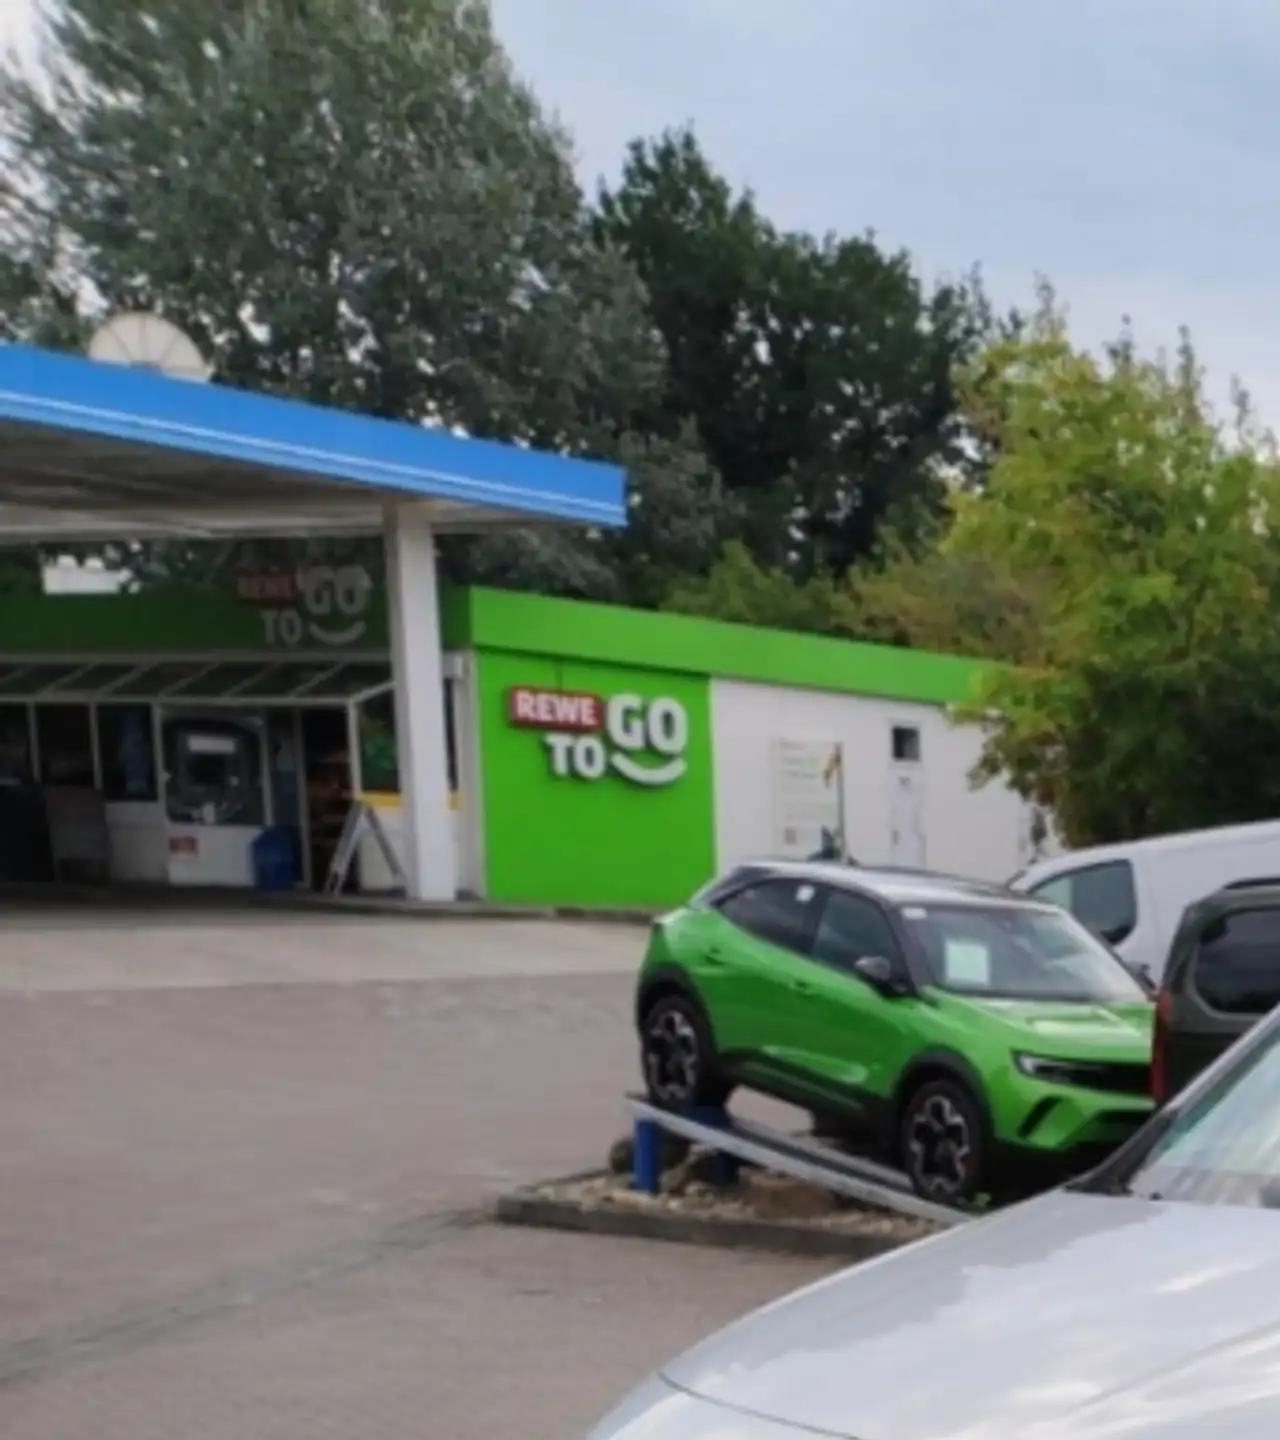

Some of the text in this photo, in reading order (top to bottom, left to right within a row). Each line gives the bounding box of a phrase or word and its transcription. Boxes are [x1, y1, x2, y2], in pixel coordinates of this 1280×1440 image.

[260, 607, 302, 645] TO
[514, 688, 599, 726] REWE
[607, 691, 688, 756] GO
[543, 733, 605, 780] TO
